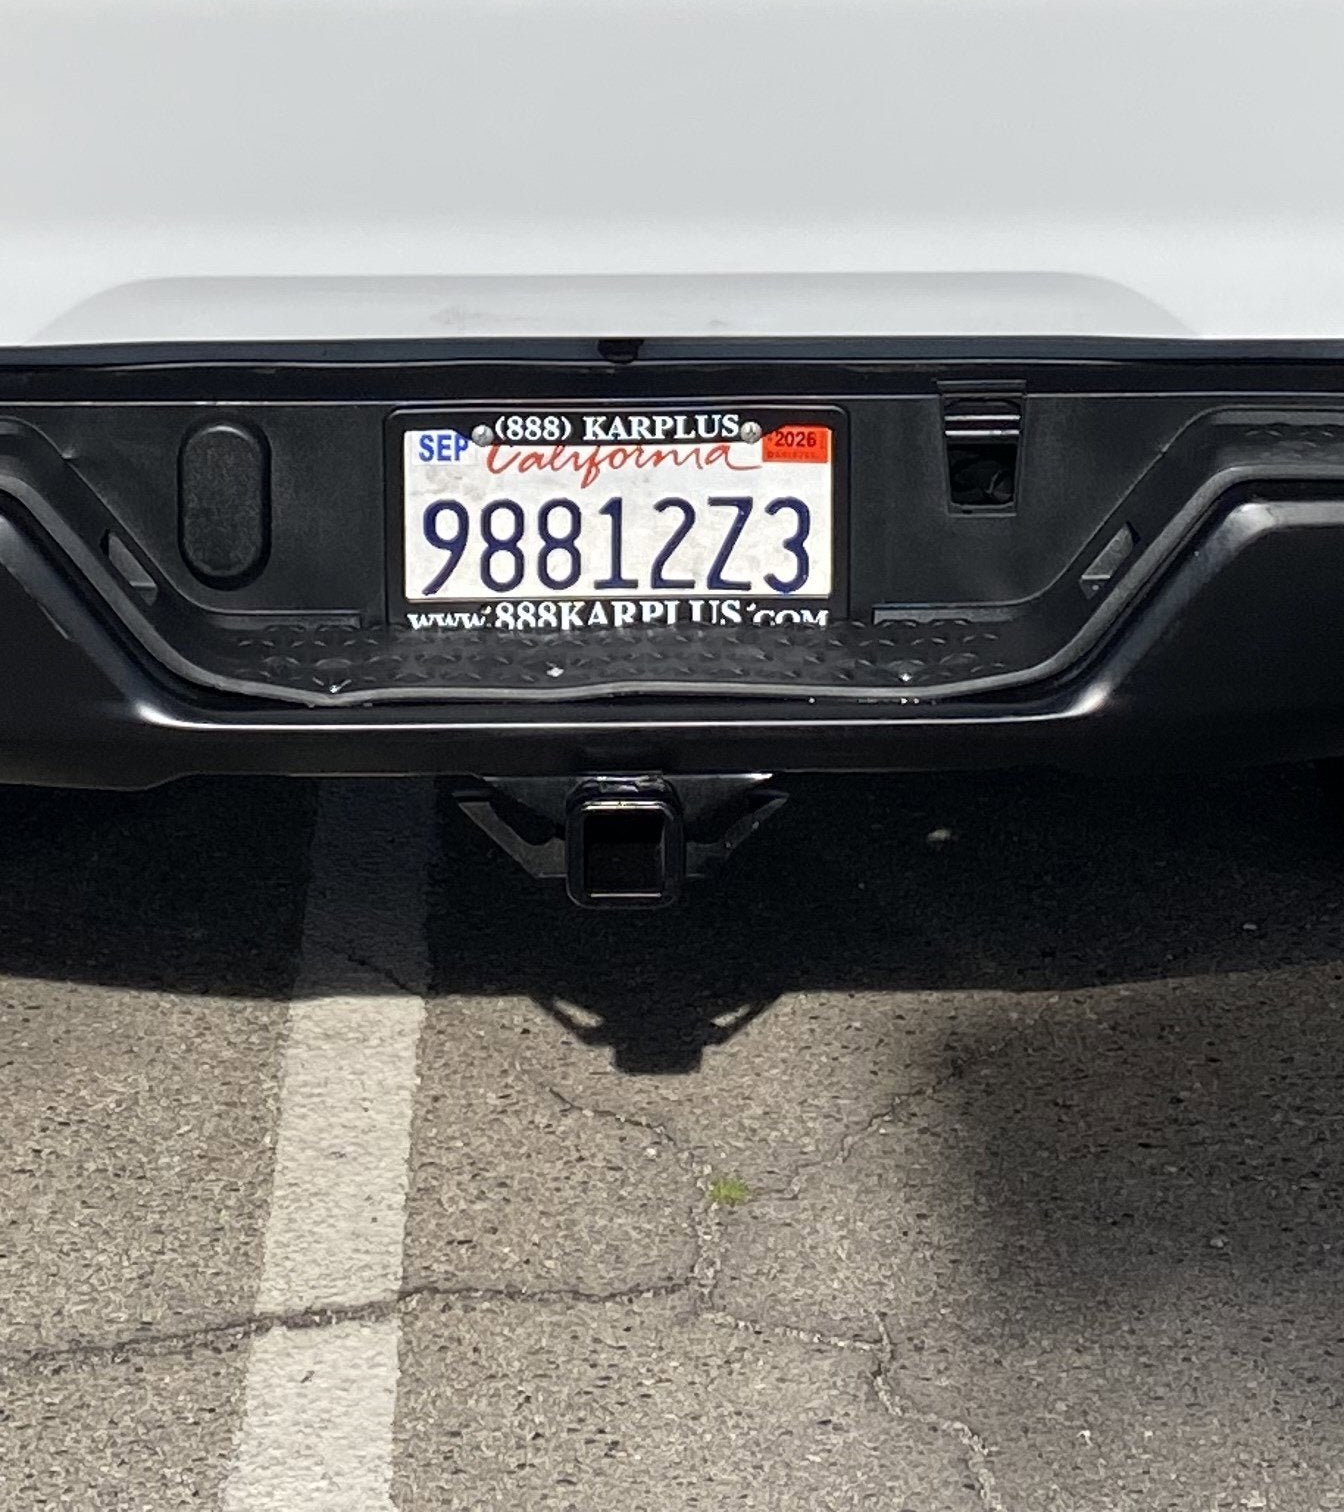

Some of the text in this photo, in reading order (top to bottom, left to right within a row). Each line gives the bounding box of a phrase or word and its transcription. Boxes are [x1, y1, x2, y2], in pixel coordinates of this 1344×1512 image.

[494, 414, 739, 441] (888) KARPLUS
[774, 430, 817, 448] 2026
[418, 434, 469, 462] SEP
[486, 444, 763, 490] California
[422, 496, 811, 595] 98812Z3
